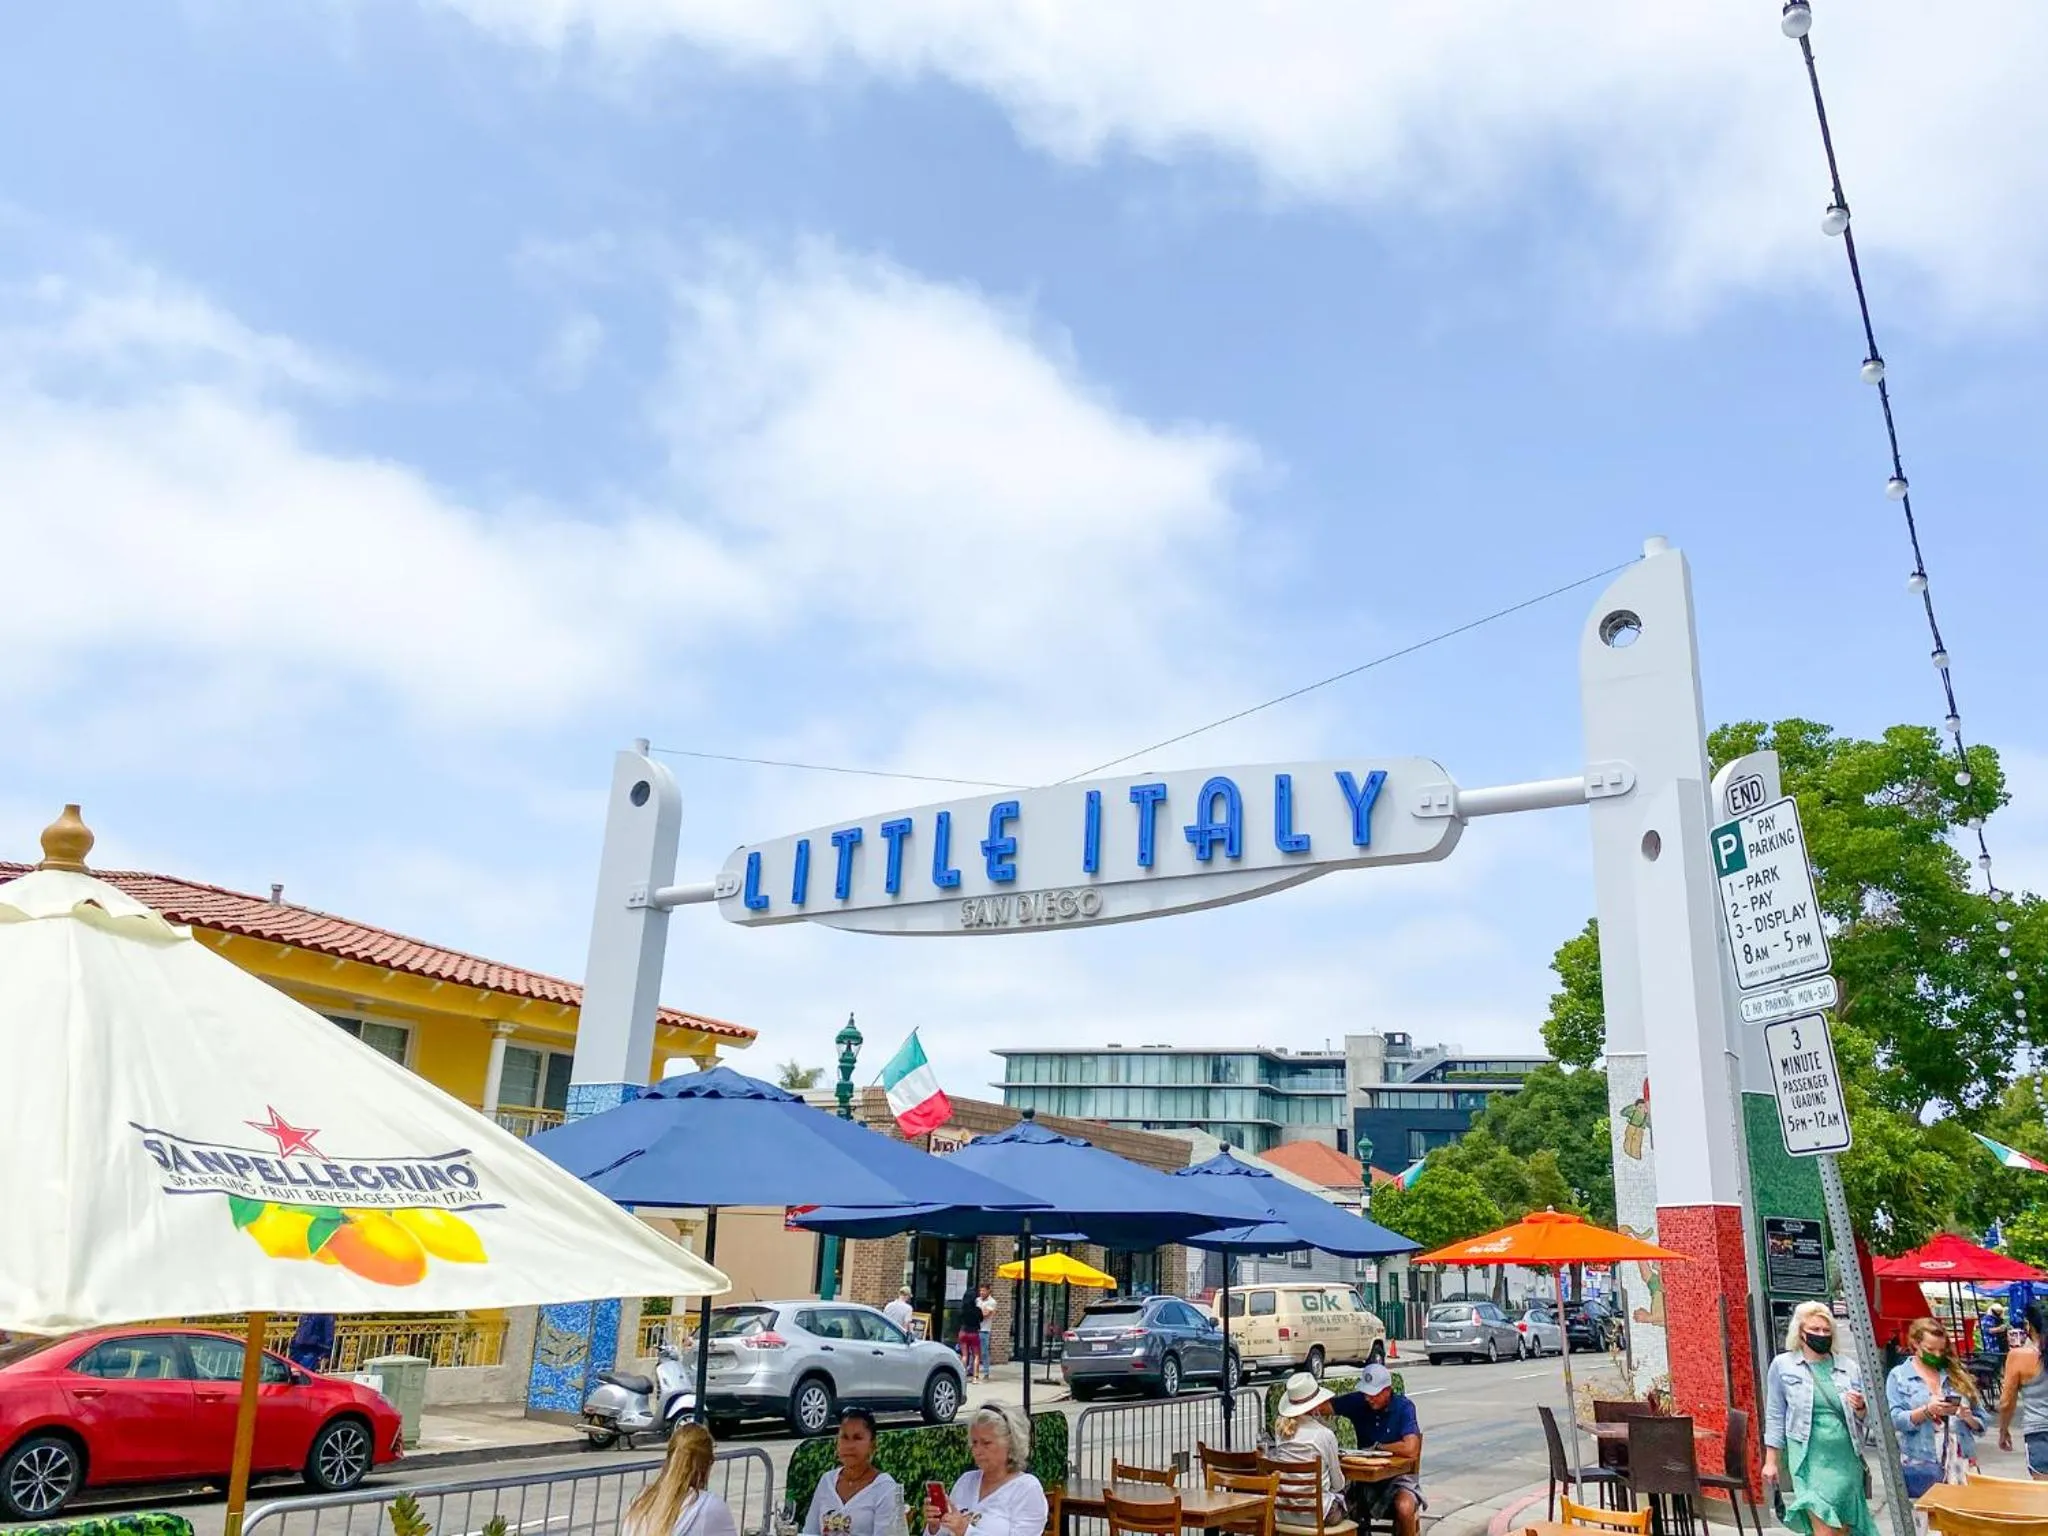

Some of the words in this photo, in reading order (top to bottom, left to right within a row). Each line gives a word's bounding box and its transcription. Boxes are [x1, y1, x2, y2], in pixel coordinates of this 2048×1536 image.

[1730, 780, 1761, 810] END
[744, 801, 1019, 909] LITTLE
[1083, 770, 1388, 872] ITALY
[1757, 814, 1776, 835] PAY
[1717, 833, 1737, 869] P
[1748, 828, 1795, 859] PARKING
[961, 895, 1009, 928] SAN
[1016, 888, 1103, 924] DIEGO
[1764, 994, 1795, 1011] PARKING
[1791, 1029, 1802, 1050] 3
[1781, 1051, 1822, 1076] MINUTE
[1782, 1074, 1829, 1095] PASSENGER
[1791, 1091, 1827, 1109] LOADING
[143, 1139, 479, 1192] SANPELLEGRINO
[169, 1174, 257, 1195] SPARKLING
[261, 1185, 303, 1200] FRUIT
[306, 1189, 396, 1204] BEVERAGES
[399, 1191, 438, 1204] FROM
[443, 1190, 483, 1205] ITALY
